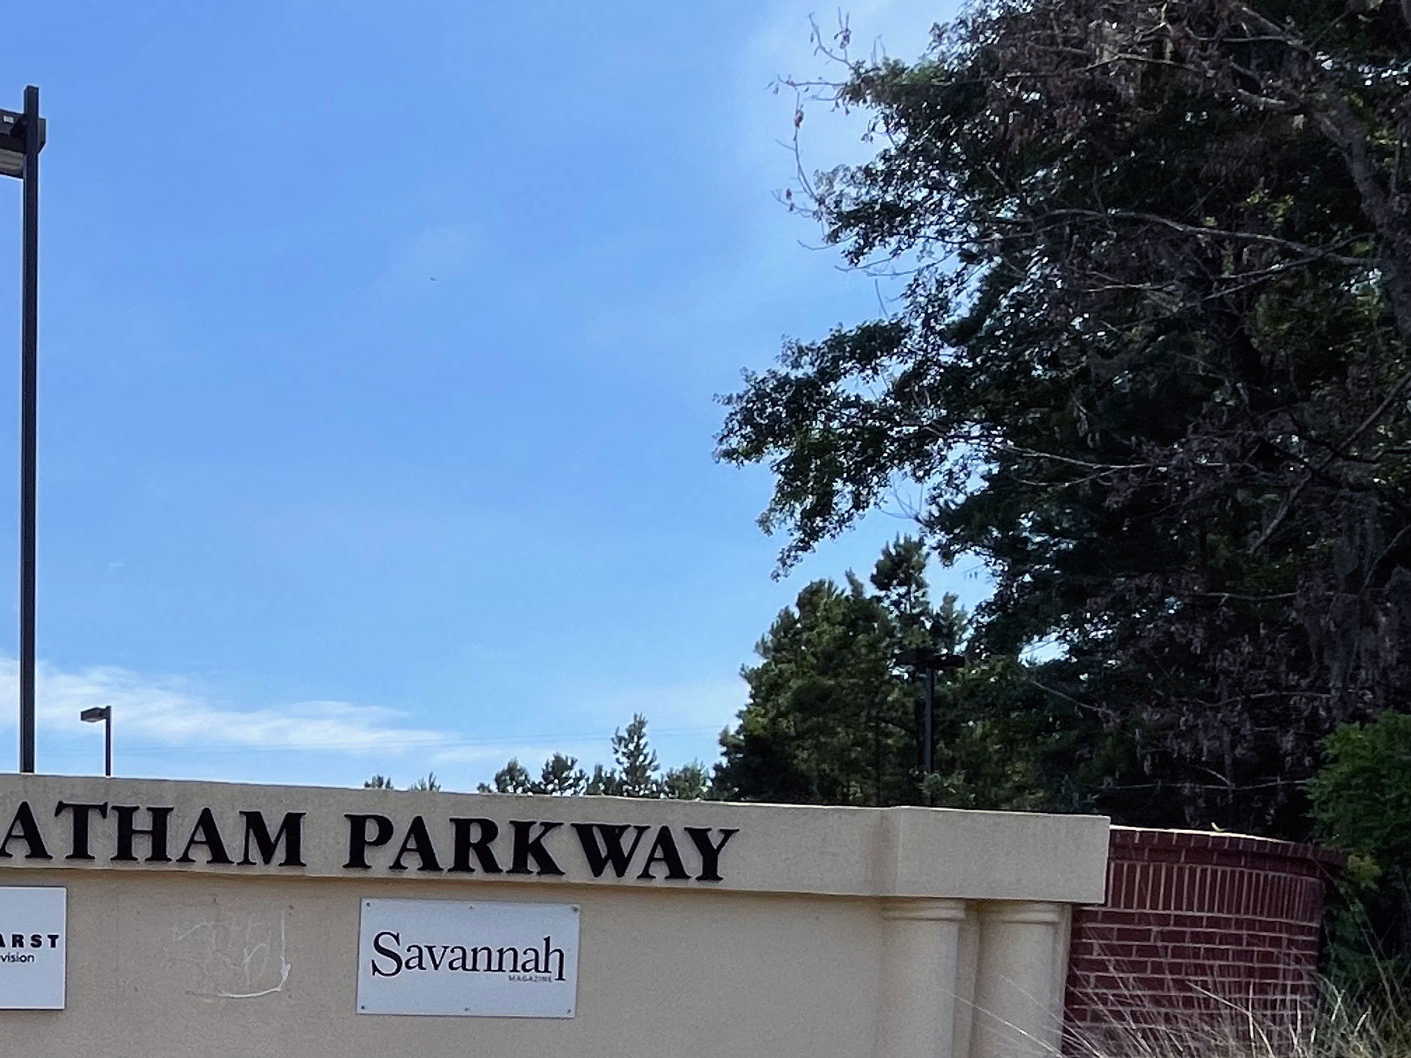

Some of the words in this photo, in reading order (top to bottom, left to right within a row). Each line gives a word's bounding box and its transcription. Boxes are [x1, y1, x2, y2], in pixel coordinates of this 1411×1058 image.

[343, 813, 739, 882] PARKWAY
[371, 931, 566, 982] Savannah
[508, 975, 553, 983] MAGAZINE
